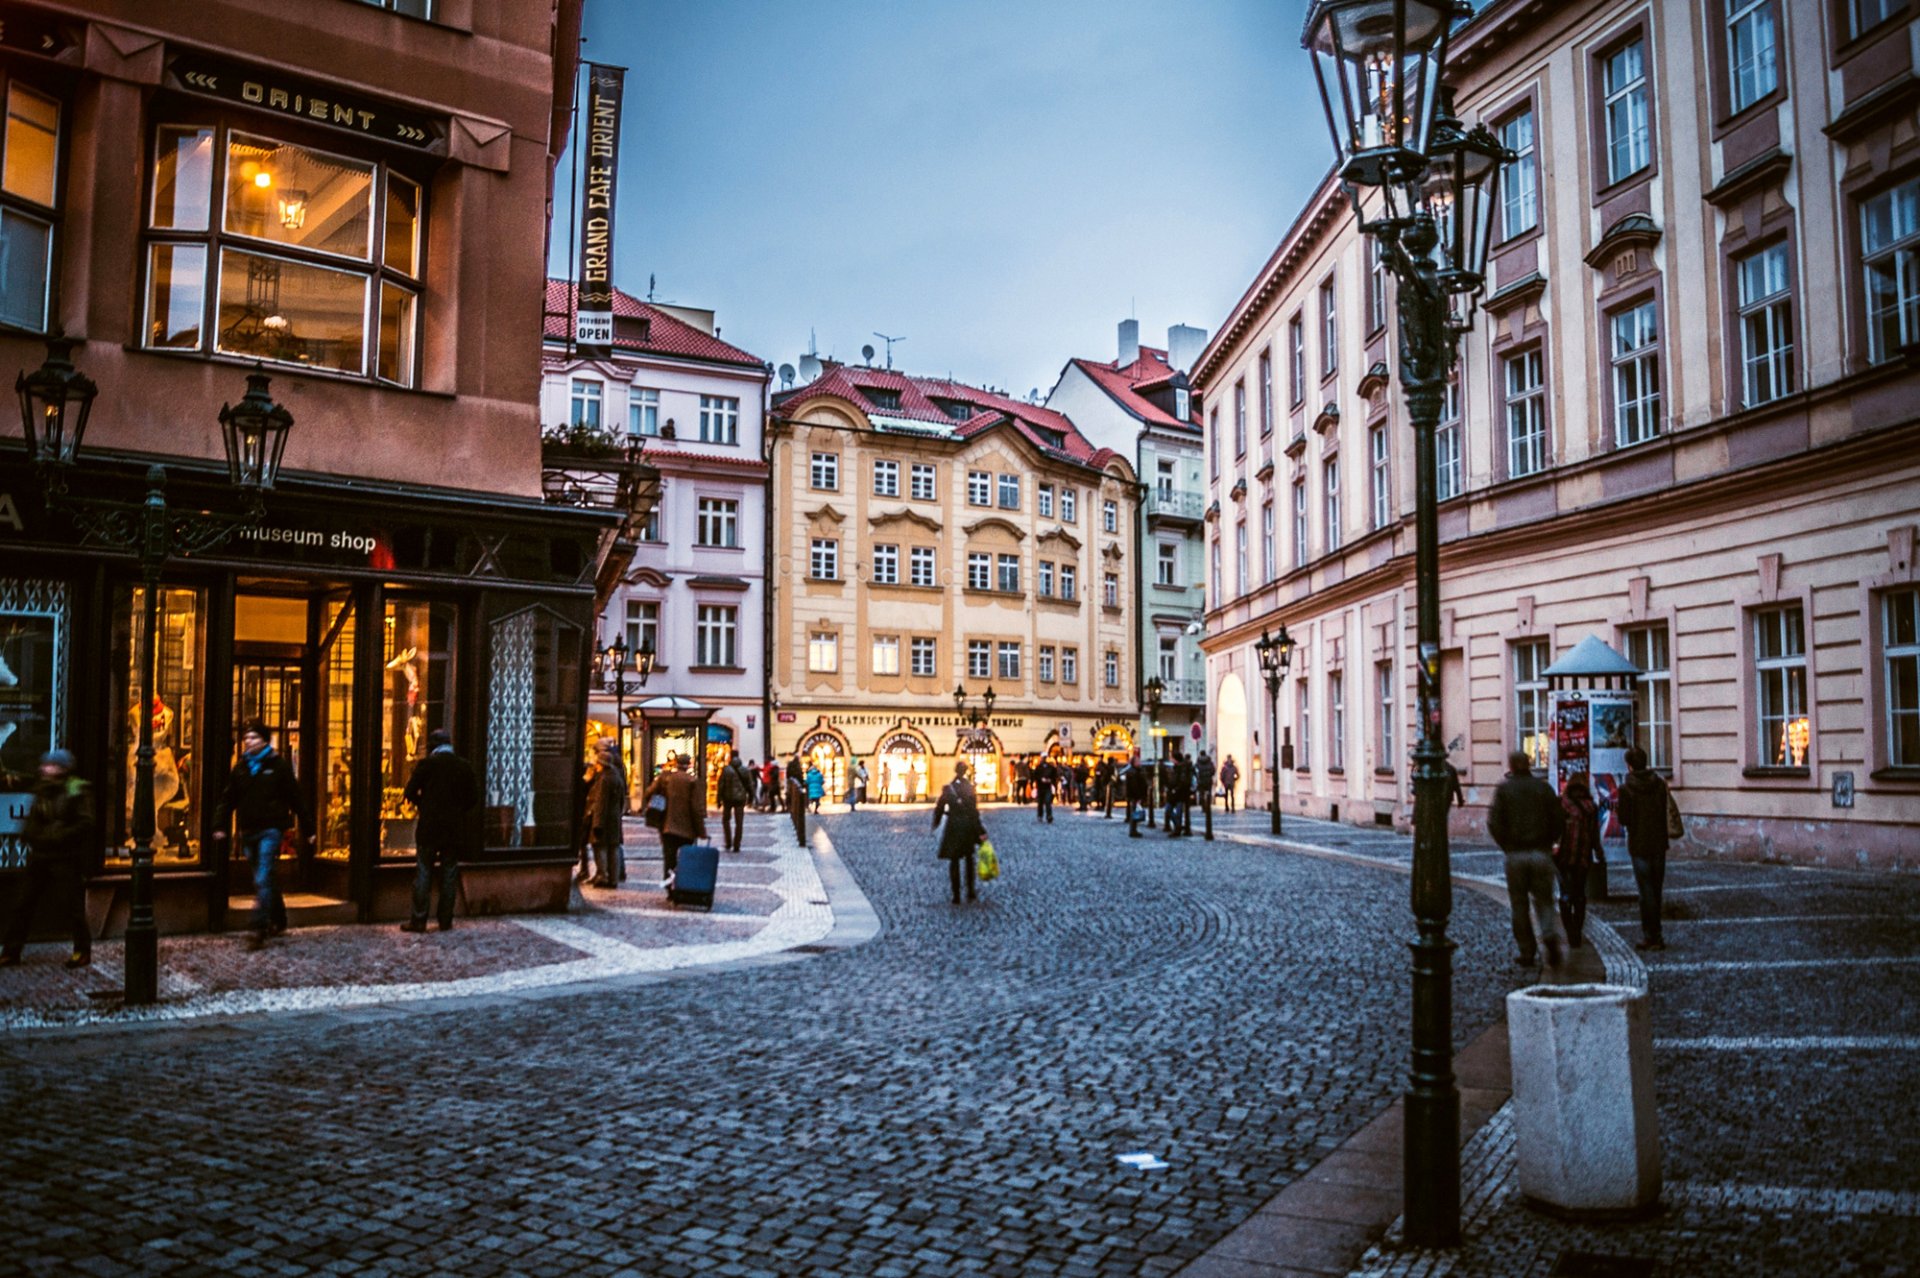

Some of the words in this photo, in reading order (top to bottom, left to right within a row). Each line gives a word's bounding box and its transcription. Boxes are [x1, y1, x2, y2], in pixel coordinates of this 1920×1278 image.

[242, 81, 375, 130] ORIENT
[591, 94, 616, 158] ORIENT
[589, 165, 612, 209] CAFE
[585, 216, 609, 283] GRAND
[579, 327, 609, 340] OPEN
[330, 530, 376, 555] shop
